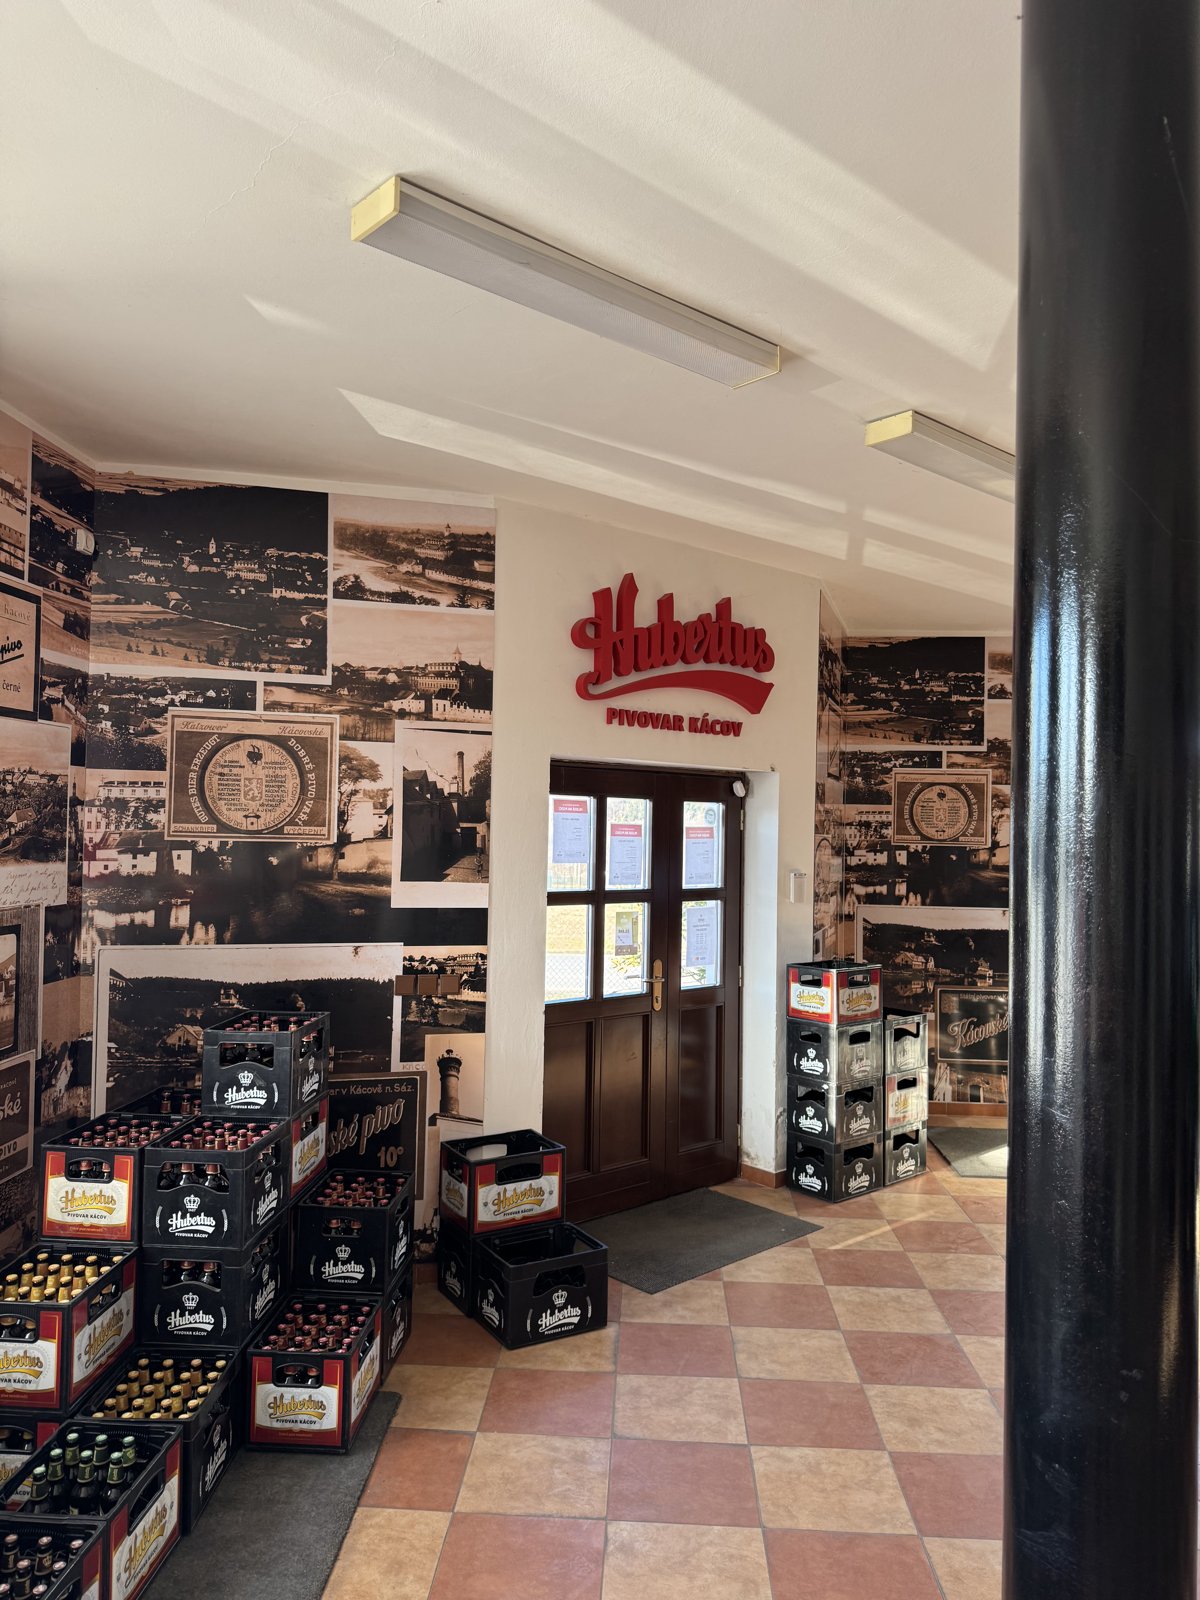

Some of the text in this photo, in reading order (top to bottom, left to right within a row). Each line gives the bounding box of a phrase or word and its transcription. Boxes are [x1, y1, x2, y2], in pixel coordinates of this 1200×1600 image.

[571, 572, 775, 685] Hubertus
[606, 707, 743, 737] PIVOVAR KÁCOV
[190, 734, 221, 771] ERZEUGT
[287, 737, 316, 772] DOBRÉ
[306, 772, 317, 799] PIVO
[188, 771, 197, 795] BIER
[224, 1086, 268, 1103] Hubertus
[349, 1083, 382, 1095] Kácově
[394, 1082, 415, 1093] Sáz.
[327, 1098, 406, 1158] ské pivo
[59, 1187, 117, 1211] Hubertus
[492, 1182, 545, 1213] Hubertus
[167, 1211, 216, 1231] Hubertus
[321, 1259, 365, 1277] Hubertus
[166, 1308, 215, 1328] Hubertus
[538, 1304, 581, 1331] Hubertus
[84, 1307, 124, 1361] Hubertus
[267, 1392, 327, 1416] Hubertus
[14, 1489, 31, 1497] ACOV
